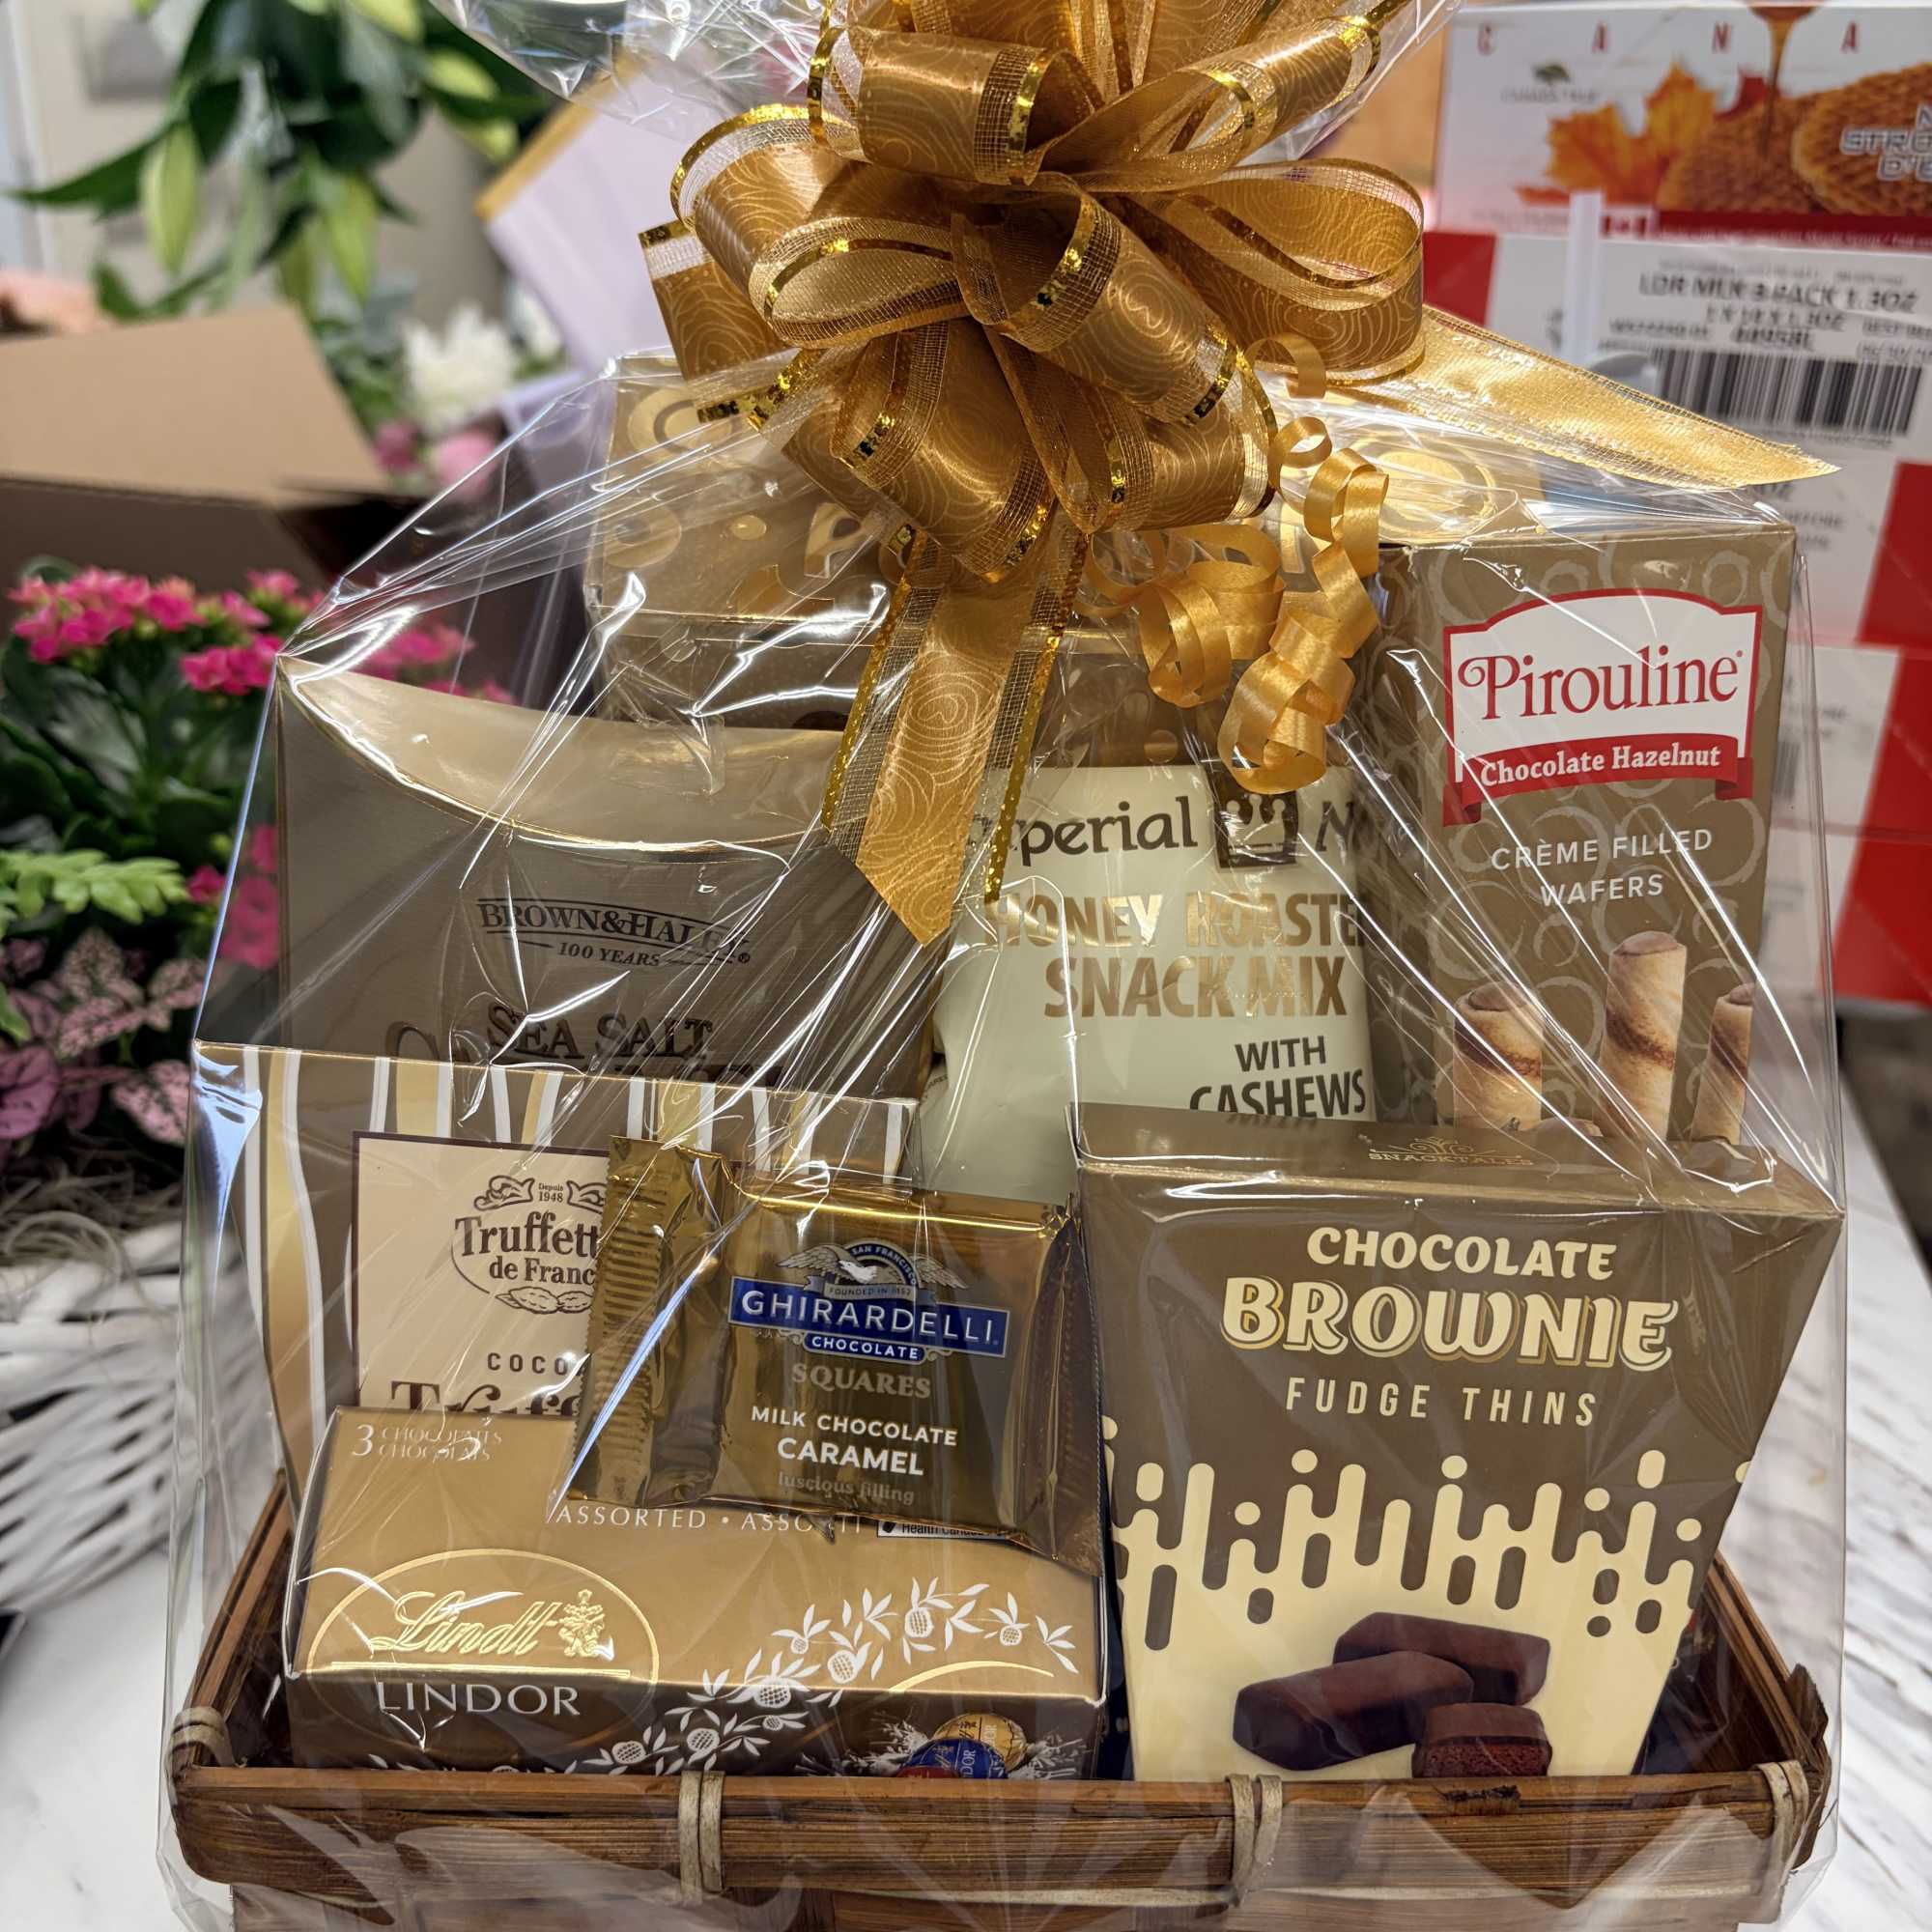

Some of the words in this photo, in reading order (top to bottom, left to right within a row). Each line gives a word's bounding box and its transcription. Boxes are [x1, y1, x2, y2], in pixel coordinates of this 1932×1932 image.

[1457, 644, 1739, 720] Pirouline
[1480, 751, 1605, 786] Chocolate
[1612, 742, 1721, 771] Hazelnut
[970, 795, 1199, 867] perial
[1491, 838, 1599, 871] CRÈME
[1612, 829, 1713, 859] FILLED
[1540, 873, 1664, 907] WAFERS
[984, 893, 1163, 948] HONEY
[1185, 892, 1364, 948] ROASTE
[557, 941, 594, 959] 100
[599, 948, 660, 967] YEARS
[1044, 955, 1236, 1018] SNACK
[1246, 955, 1348, 1017] MIX
[487, 1003, 585, 1059] SEA
[593, 1012, 713, 1060] SALT
[1234, 1036, 1327, 1073] WITH
[1189, 1068, 1367, 1119] CASHEWS
[538, 1182, 564, 1192] Depuis
[538, 1191, 564, 1203] 1948
[489, 1256, 519, 1280] de
[525, 1257, 596, 1286] Franc
[851, 1245, 872, 1256] SAN
[874, 1246, 917, 1286] FRANCISCO
[1306, 1226, 1617, 1281] CHOCOLATE
[741, 1290, 993, 1344] GHIRARDELLI
[1220, 1276, 1679, 1372] BROWNIE
[487, 1352, 582, 1377] COCO
[810, 1335, 920, 1360] CHOCOLATE
[791, 1362, 931, 1399] SQUARES
[1285, 1377, 1432, 1419] FUDGE
[1463, 1386, 1598, 1428] THINS
[352, 1424, 375, 1457] 3
[751, 1405, 807, 1428] MILK
[816, 1414, 958, 1447] CHOCOLATE
[776, 1436, 924, 1476] CARAMEL
[859, 1482, 915, 1507] filling
[555, 1505, 707, 1529] ASSORTED
[741, 1512, 861, 1534] ASSOTI
[369, 1590, 562, 1656] Lindt
[375, 1681, 581, 1716] LINDOR
